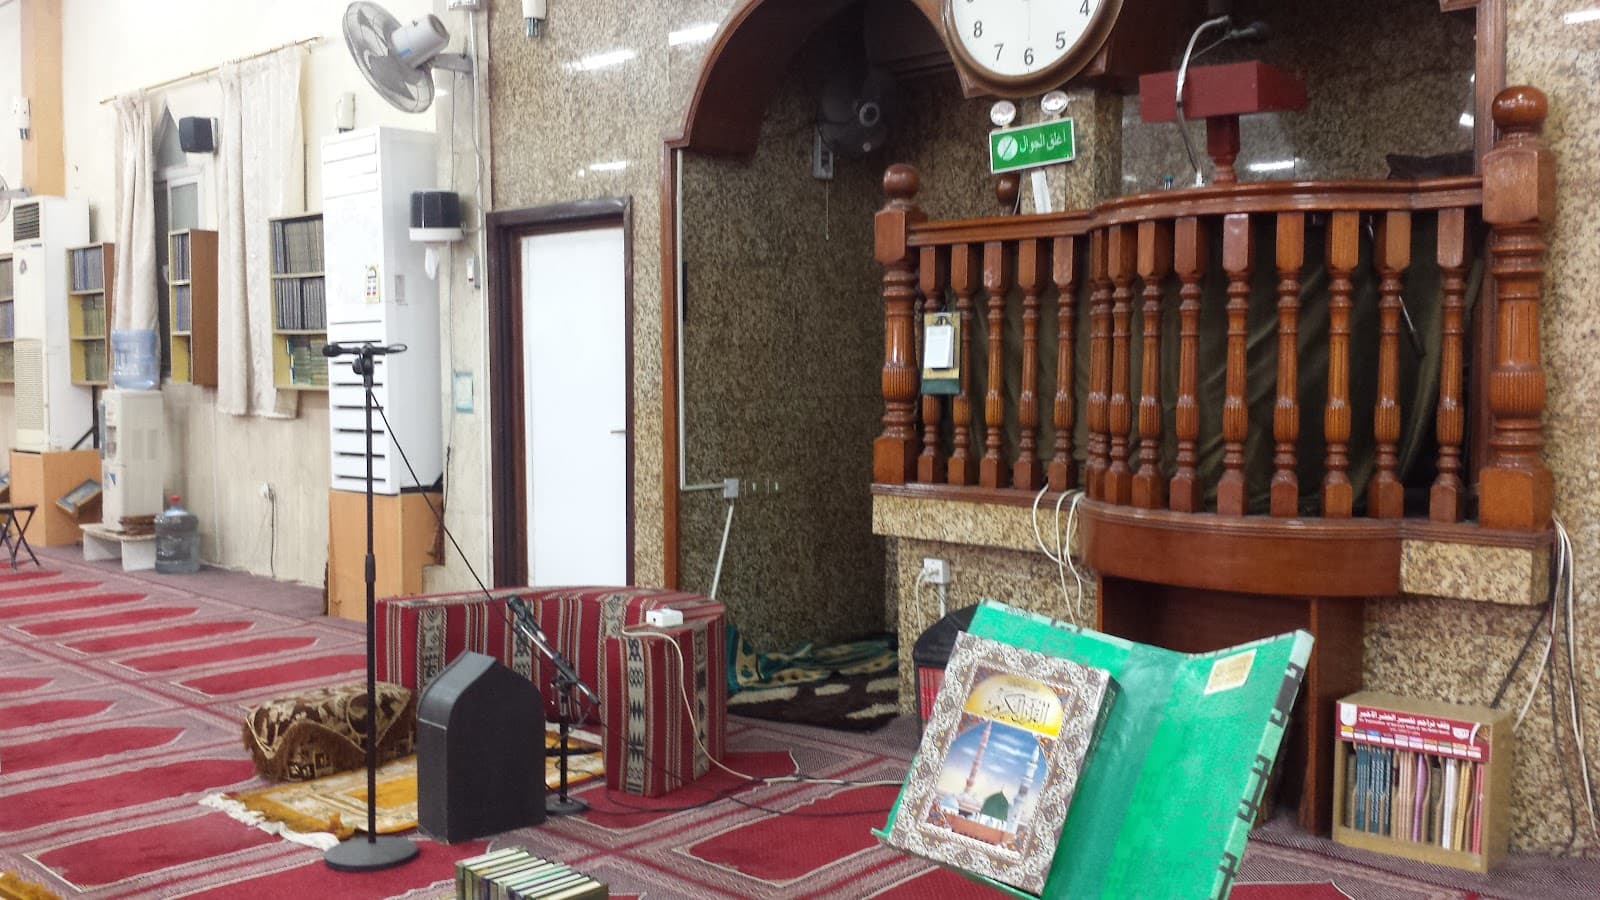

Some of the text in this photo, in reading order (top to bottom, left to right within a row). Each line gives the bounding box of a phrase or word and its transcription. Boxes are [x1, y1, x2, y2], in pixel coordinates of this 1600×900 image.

[1079, 0, 1091, 17] 4
[973, 20, 983, 39] 8
[1055, 31, 1066, 50] 5
[994, 43, 1004, 62] 7
[1023, 47, 1034, 66] 6
